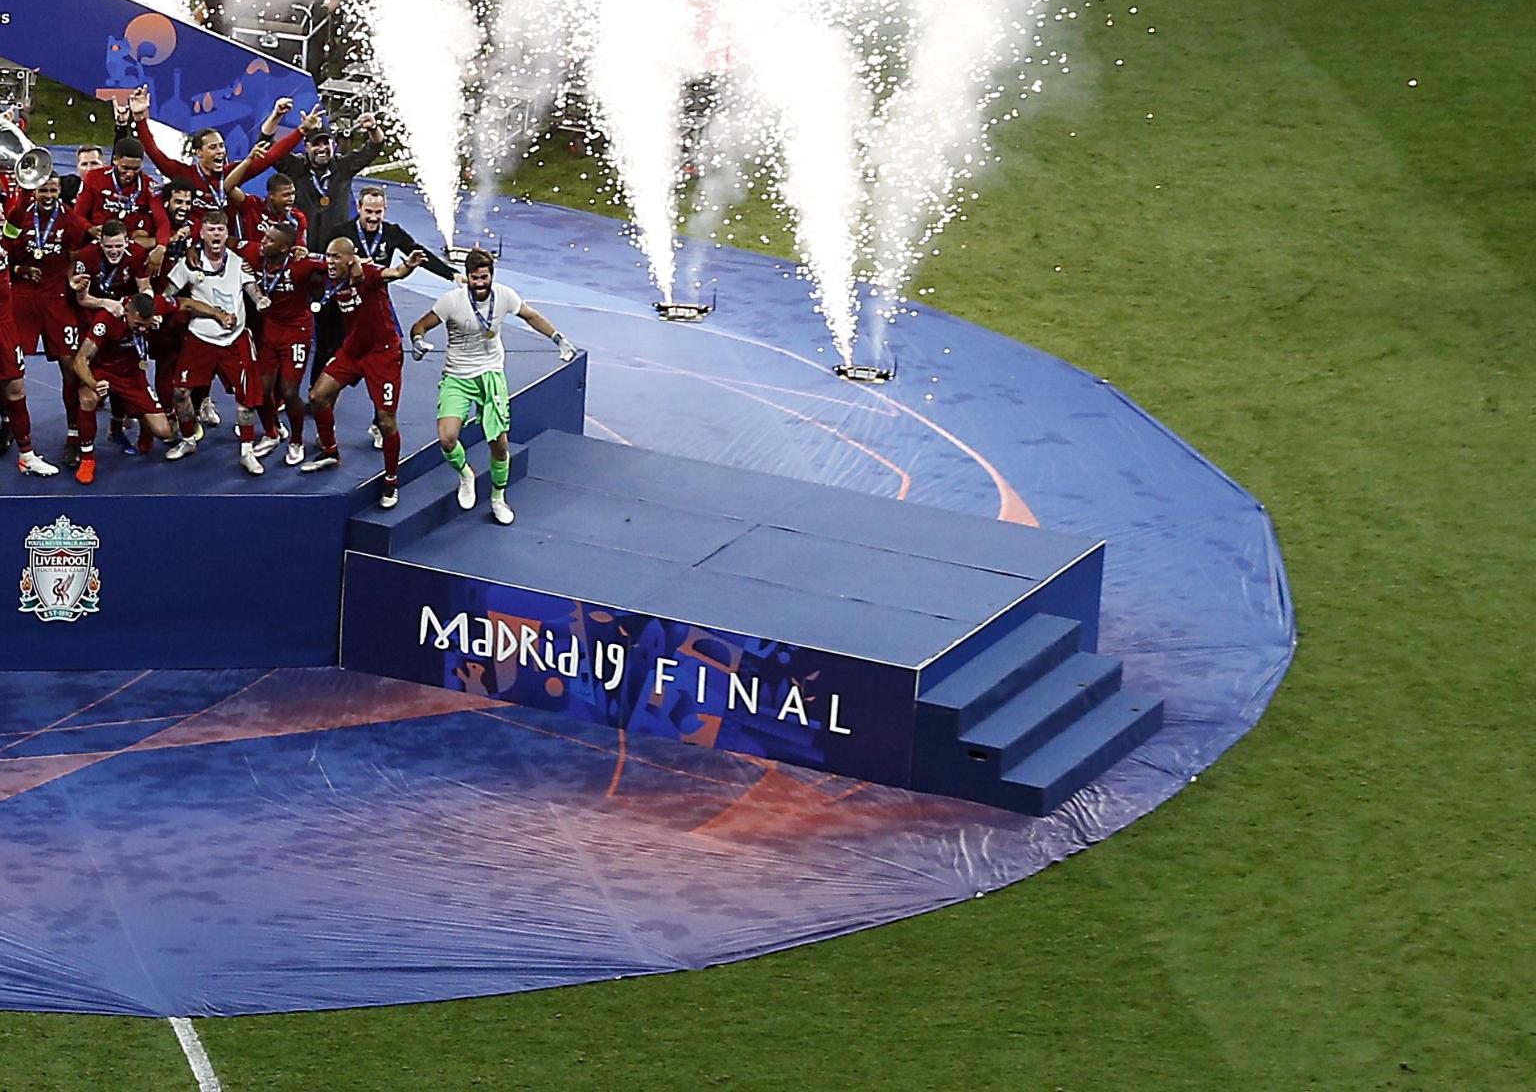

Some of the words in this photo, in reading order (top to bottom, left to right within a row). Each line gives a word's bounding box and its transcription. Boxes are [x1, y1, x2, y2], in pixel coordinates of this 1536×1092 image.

[291, 344, 305, 362] 15
[383, 383, 393, 400] 3
[35, 556, 88, 566] LIVERPOOL
[654, 657, 852, 736] FINAL
